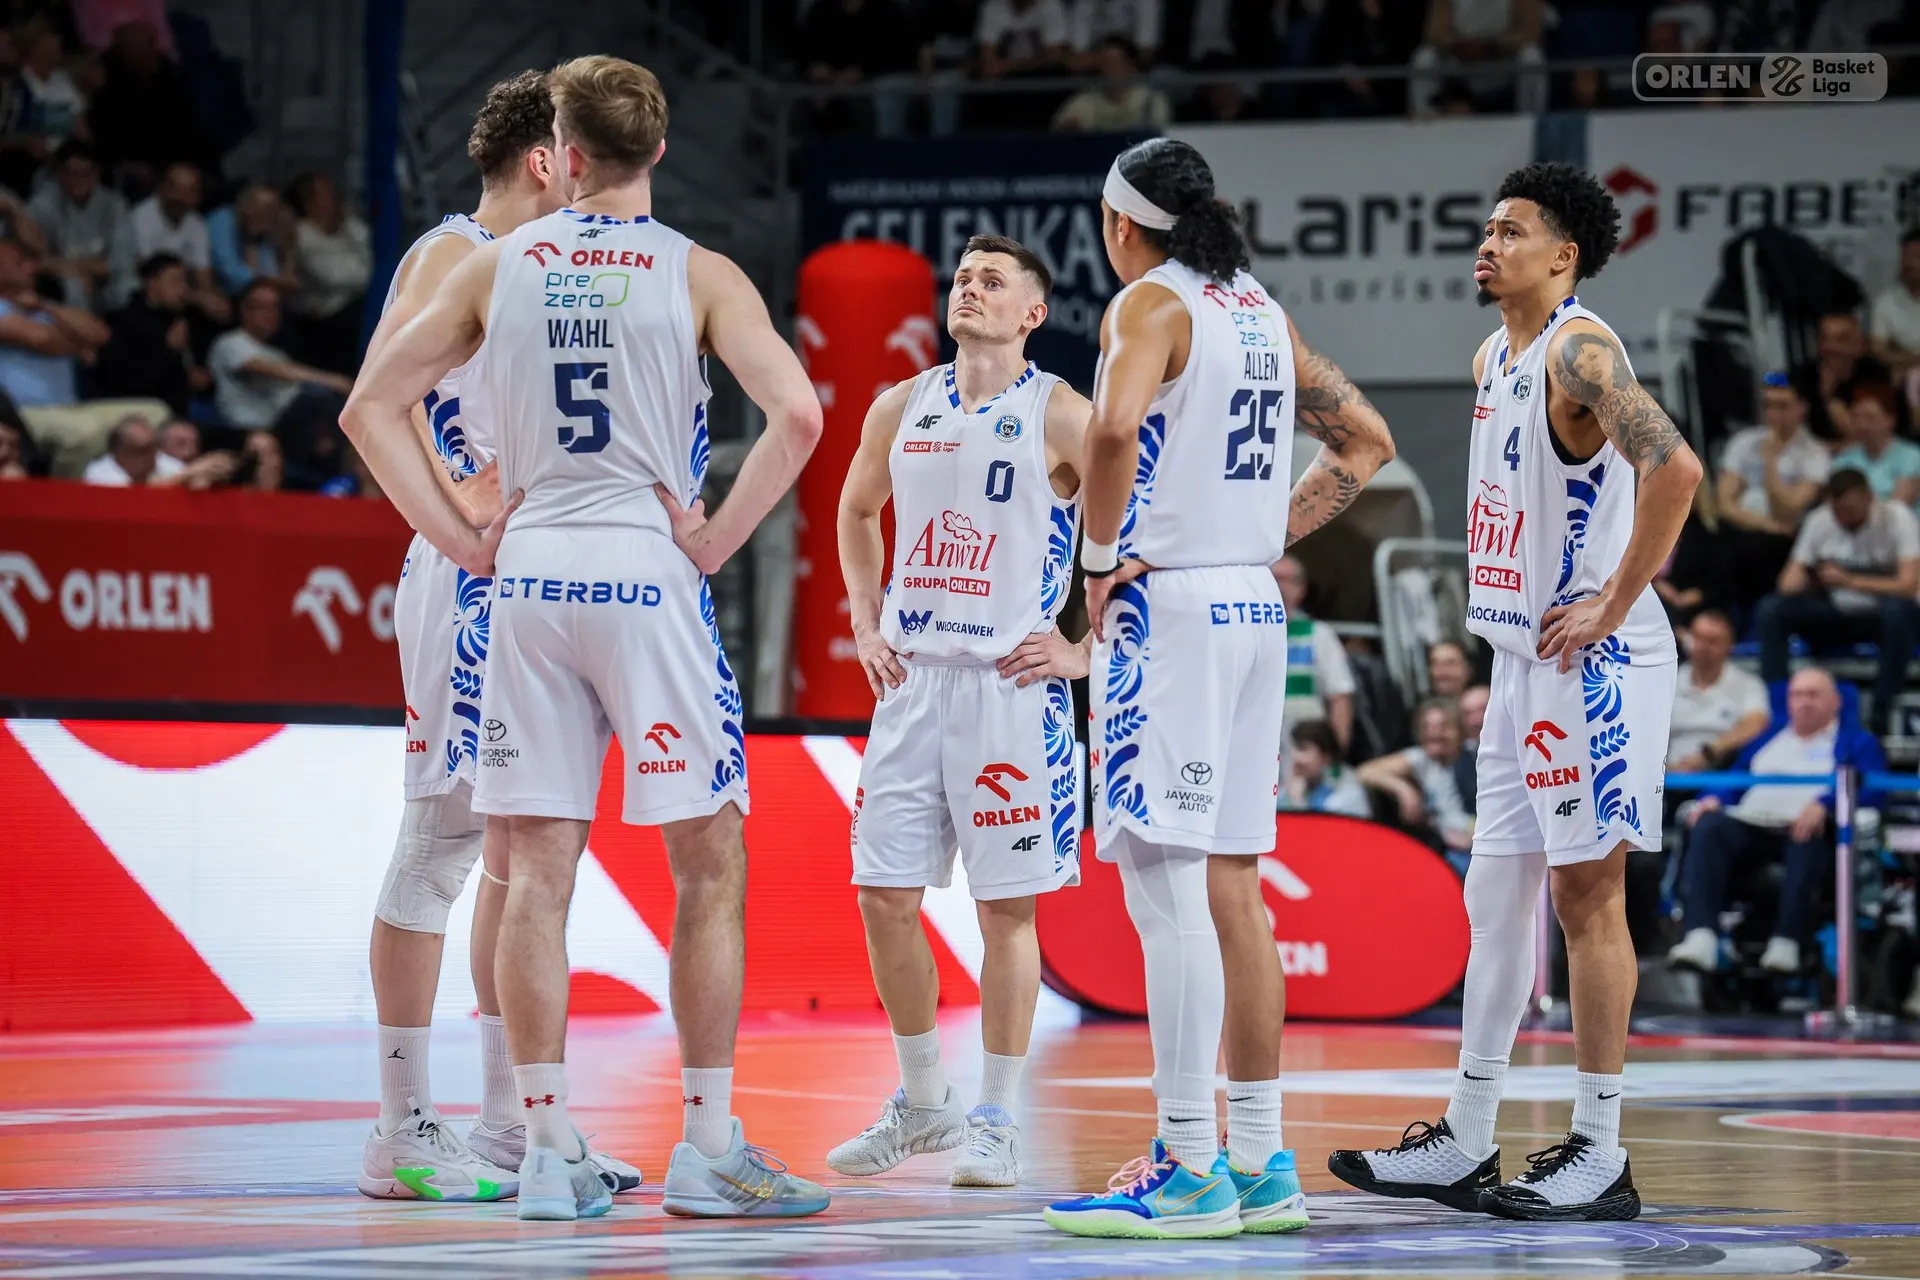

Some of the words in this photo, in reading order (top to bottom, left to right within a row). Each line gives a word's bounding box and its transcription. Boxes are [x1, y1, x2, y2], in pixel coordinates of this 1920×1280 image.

[1245, 194, 1486, 258] Laris
[571, 249, 654, 270] ORLEN
[545, 272, 590, 289] pre
[544, 293, 604, 308] zero
[548, 318, 614, 348] WAHL
[1244, 352, 1279, 381] ALLEN
[554, 362, 611, 454] 5
[915, 414, 943, 429] 4F
[1224, 389, 1284, 480] 25
[904, 442, 930, 452] ORLEN
[1503, 426, 1521, 471] 4
[985, 460, 1015, 503] 0
[1467, 493, 1525, 559] Awl
[904, 517, 998, 572] Anwil
[903, 576, 947, 589] GRUPA
[950, 578, 987, 594] ORLEN
[1477, 568, 1519, 588] ORLE
[60, 568, 213, 632] ORLEN
[519, 577, 662, 607] TERBUD
[1232, 602, 1285, 624] TERB
[638, 759, 686, 774] ORLEN
[1526, 765, 1580, 790] ORLEN
[1165, 790, 1214, 804] JAWORSK
[1555, 798, 1581, 817] 4F
[973, 805, 1041, 827] ORLEN
[1011, 834, 1042, 852] 4F
